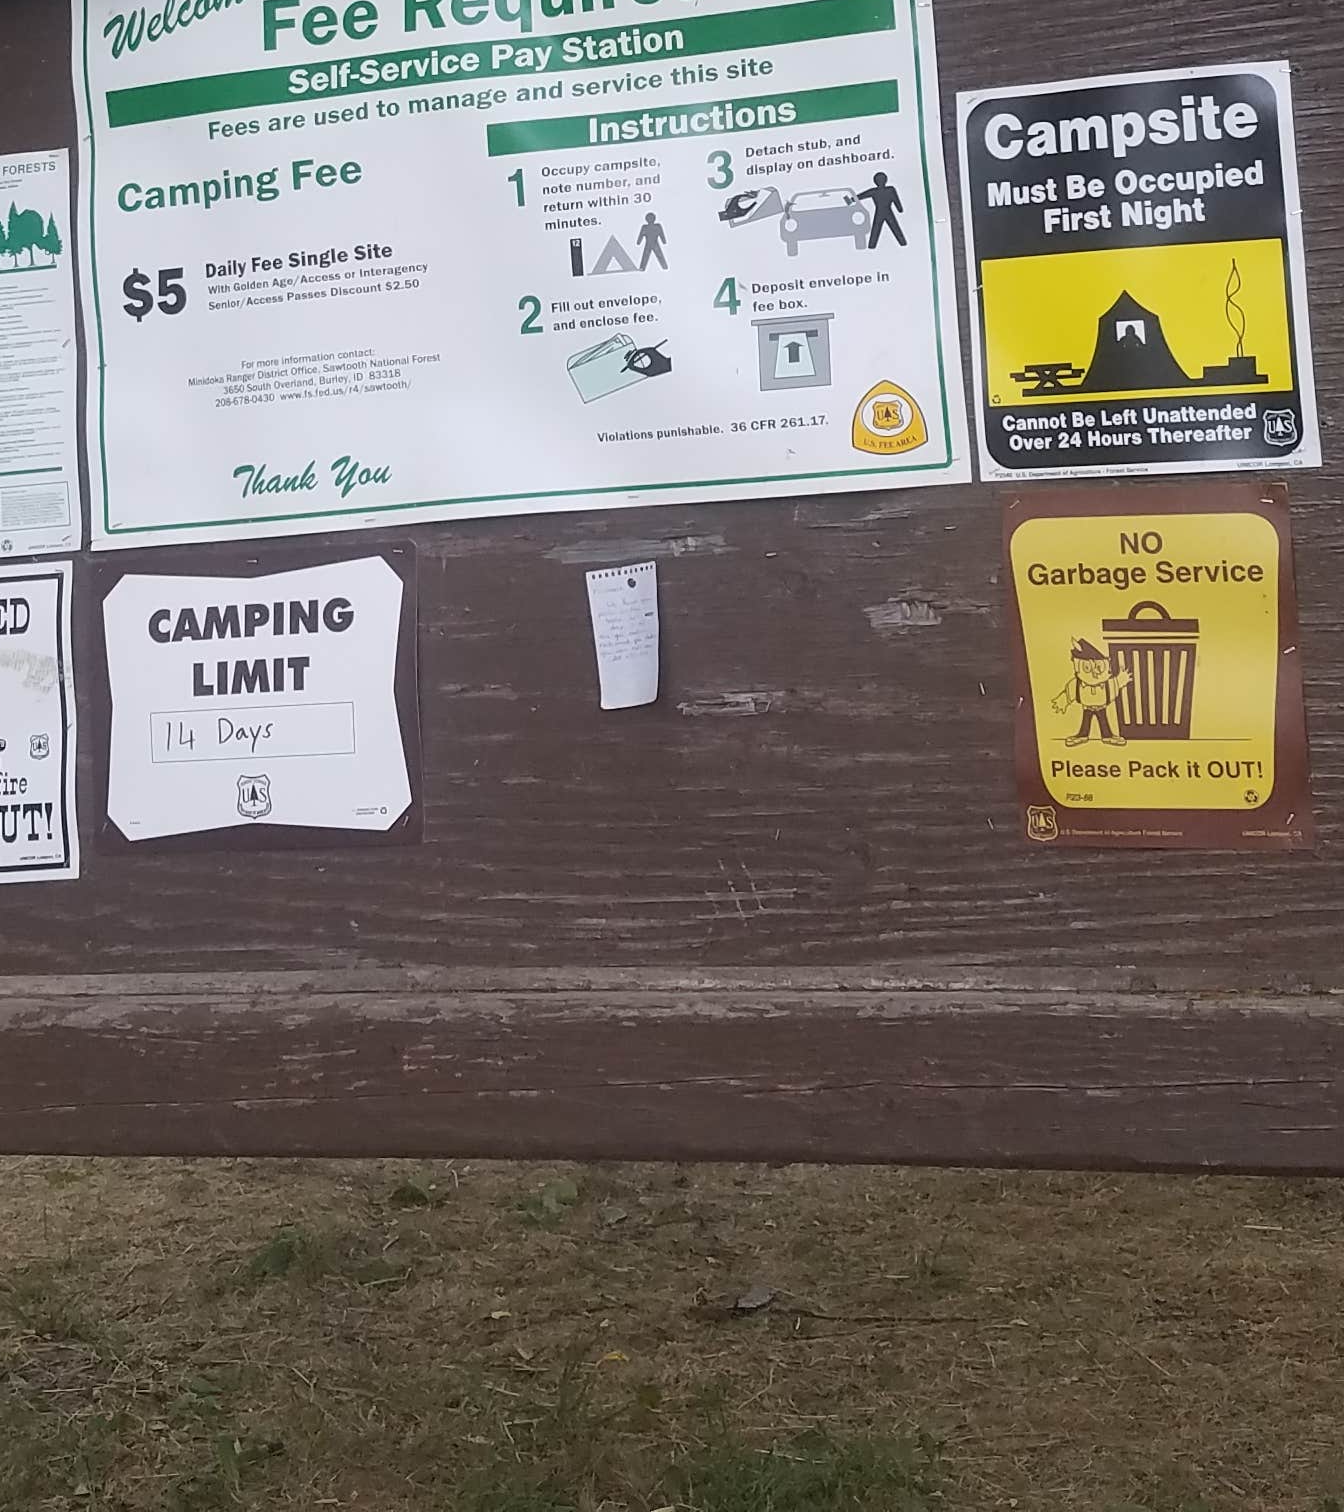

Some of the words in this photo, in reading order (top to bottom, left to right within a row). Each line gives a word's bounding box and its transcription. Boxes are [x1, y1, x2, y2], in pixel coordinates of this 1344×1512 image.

[288, 48, 480, 95] Self-Service
[491, 44, 553, 74] Pay
[562, 27, 684, 63] Station
[208, 121, 260, 140] Fees
[268, 115, 306, 131] are
[314, 103, 369, 128] used
[376, 101, 401, 119] to
[409, 89, 508, 113] manage
[516, 81, 564, 101] and
[572, 73, 663, 96] service
[671, 65, 719, 86] this
[726, 57, 774, 79] site
[589, 101, 796, 144] Instructions
[984, 95, 1258, 161] Campsite
[746, 142, 793, 158] Detach
[798, 138, 831, 152] stub,
[836, 135, 861, 147] and
[3, 161, 56, 176] FORESTS
[542, 164, 590, 177] Occupy
[594, 157, 661, 172] campsite,
[707, 150, 733, 189] 3
[746, 159, 793, 175] display
[797, 158, 814, 169] on
[817, 149, 894, 168] dashboard.
[117, 168, 279, 212] Camping
[292, 159, 362, 190] Fee
[508, 168, 525, 207] 1
[542, 183, 572, 195] note
[576, 178, 631, 193] number,
[635, 174, 660, 186] and
[988, 180, 1057, 207] Must
[1066, 175, 1105, 200] Be
[1115, 160, 1264, 196] Occupied
[543, 196, 583, 213] return
[588, 194, 629, 208] within
[633, 193, 652, 204] 30
[1044, 203, 1111, 233] First
[1121, 198, 1206, 231] Night
[545, 216, 602, 230] minutes.
[205, 259, 247, 279] Daily
[251, 257, 283, 273] Fee
[288, 248, 348, 268] Single
[354, 244, 393, 261] Site
[208, 285, 231, 295] With
[233, 280, 269, 292] Golden
[344, 271, 356, 279] or
[359, 263, 428, 278] Interagency
[751, 279, 804, 294] Deposit
[809, 273, 872, 289] envelope
[877, 272, 889, 283] in
[123, 268, 187, 322] $5
[209, 294, 284, 311] Senior/Access
[287, 290, 327, 302] Passes
[331, 284, 381, 297] Discount
[385, 279, 419, 291] $2.50
[551, 302, 570, 313] Fill
[574, 300, 594, 310] out
[599, 294, 662, 309] envelope,
[713, 277, 741, 316] 4
[753, 301, 775, 312] fee
[779, 299, 807, 310] box.
[519, 295, 543, 334] 2
[553, 319, 576, 331] and
[580, 314, 630, 328] enclose
[633, 312, 658, 324] fee.
[227, 372, 255, 383] Ranger
[258, 367, 288, 378] District
[323, 361, 367, 373] Sawtooth
[370, 356, 409, 368] National
[412, 353, 440, 363] Forest
[242, 361, 254, 369] For
[257, 358, 279, 368] more
[282, 353, 335, 365] information
[247, 382, 271, 392] South
[354, 373, 363, 381] ID
[369, 369, 401, 380] 83318
[597, 429, 654, 443] Violations
[656, 425, 724, 439] punishable.
[730, 422, 747, 433] 36
[751, 419, 776, 431] CFR
[780, 415, 828, 429] 261.17.
[1002, 413, 1067, 432] Cannot
[1072, 412, 1095, 428] Be
[1101, 409, 1137, 427] Left
[1143, 402, 1256, 423] Unattended
[896, 435, 917, 447] AREA
[1009, 434, 1053, 451] Over
[1058, 432, 1081, 449] 24
[1088, 428, 1142, 446] Hours
[1148, 425, 1252, 444] Thereafter
[233, 460, 318, 498] Thank
[330, 456, 392, 498] You
[1120, 531, 1163, 554] NO
[1027, 563, 1146, 590] Garbage
[1156, 560, 1264, 583] Service
[148, 597, 355, 643] CAMPING
[193, 656, 310, 697] LIMIT
[164, 722, 196, 752] 14
[218, 717, 274, 753] Days
[1051, 760, 1121, 778] Please
[1129, 760, 1179, 778] Pack
[1187, 760, 1200, 778] it
[1207, 760, 1263, 779] OUT!
